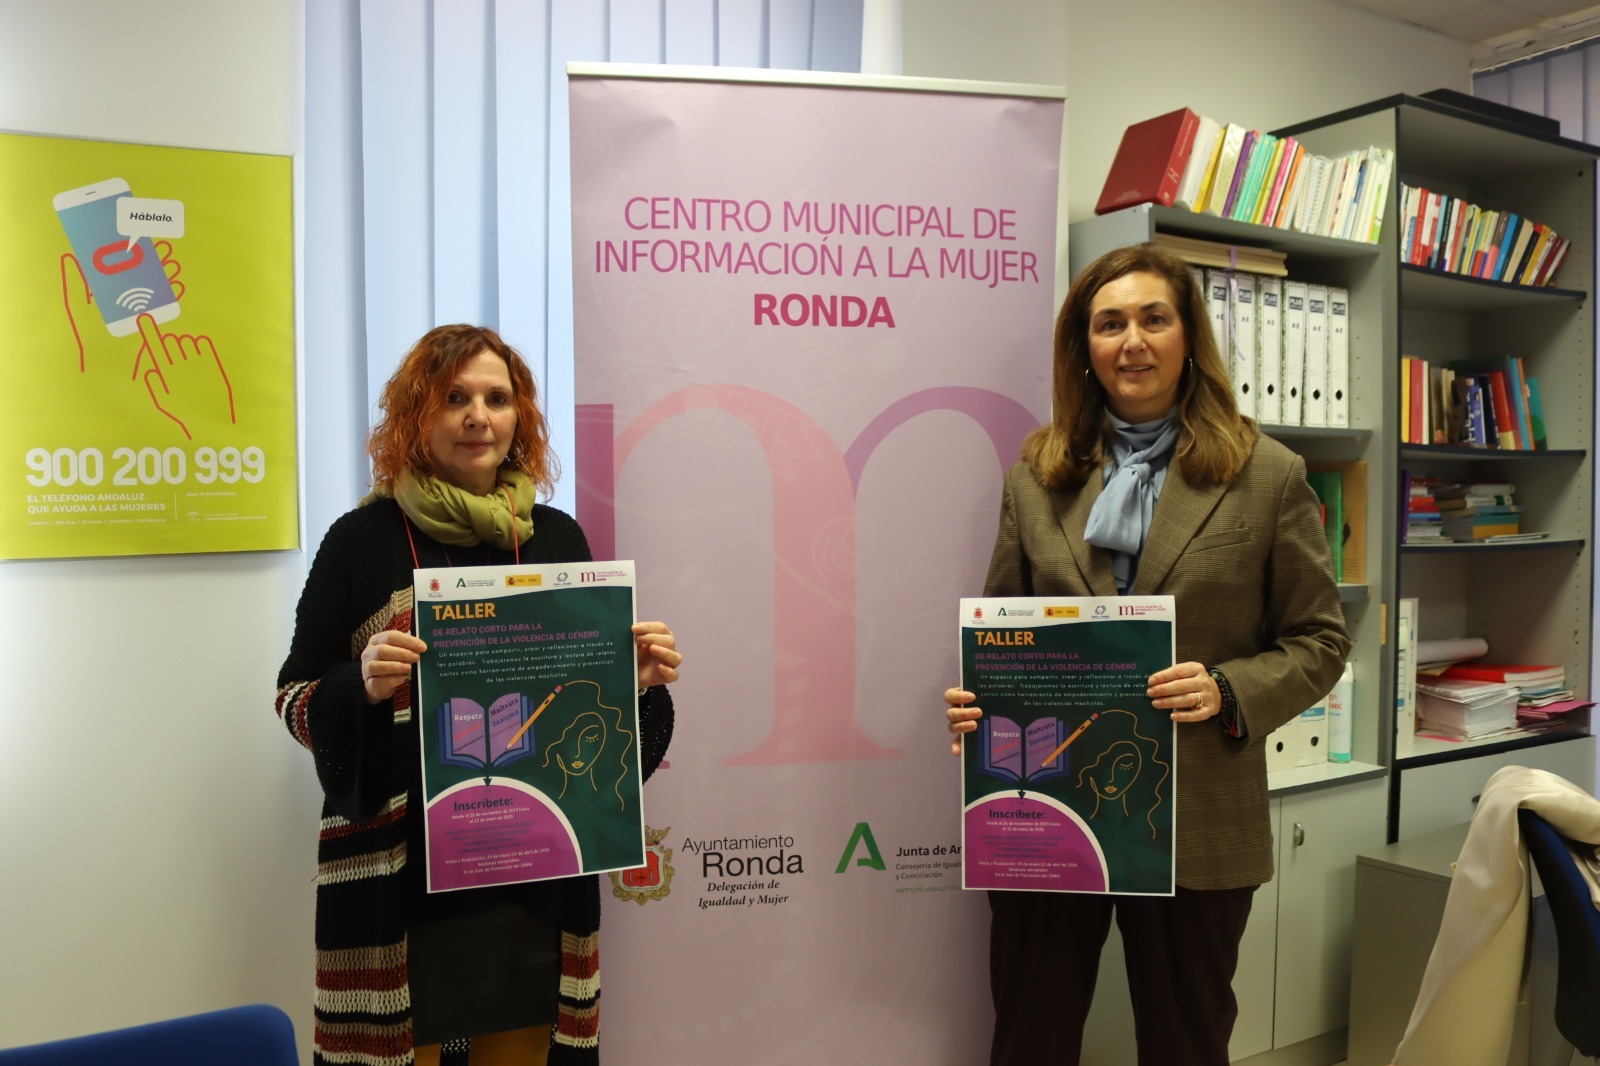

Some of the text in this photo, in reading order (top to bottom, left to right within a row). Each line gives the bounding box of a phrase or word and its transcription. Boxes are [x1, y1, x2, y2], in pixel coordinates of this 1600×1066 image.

[129, 211, 174, 223] Háblalo.
[623, 196, 1017, 241] CENTRO MUNICIPAL DE
[595, 236, 1040, 289] INFORMACIÓN A LA MUJER
[753, 292, 897, 329] RONDA
[25, 446, 266, 487] 900 200 999
[27, 492, 145, 503] EL TELÉFONO ANDALUZ
[27, 505, 50, 514] QUE
[52, 505, 88, 513] AYUDA
[99, 504, 118, 512] LAS
[120, 503, 166, 511] MUJERES
[432, 602, 497, 621] TALLER
[433, 623, 542, 637] DE RELATO CORTO PARA LA
[433, 637, 487, 648] PREVENCIÓN
[488, 637, 499, 645] DE
[512, 634, 555, 643] VIOLENCIA
[556, 632, 567, 641] DE
[568, 630, 599, 640] GÉNERO
[975, 631, 1035, 646] TALLER
[975, 652, 1080, 660] DE RELATO CORTO PARA LA
[975, 661, 1137, 671] PREVENCIÓN DE LA VIOLENCIA DE GÉNERO
[490, 699, 519, 716] Maltrato
[492, 711, 519, 727] Sexismo
[993, 731, 1020, 739] Respeto
[1027, 722, 1055, 736] Maltrato
[454, 797, 514, 812] Inscríbete:
[989, 809, 1045, 819] Inscríbete:
[682, 834, 794, 855] Ayuntamiento
[896, 847, 929, 857] Junta
[932, 845, 947, 855] de
[703, 849, 804, 878] Ronda
[896, 862, 929, 872] Consejería
[933, 861, 943, 869] de
[901, 872, 942, 880] Conciliación
[707, 879, 780, 893] Delegación de
[698, 894, 789, 910] Igualdad y Mujer
